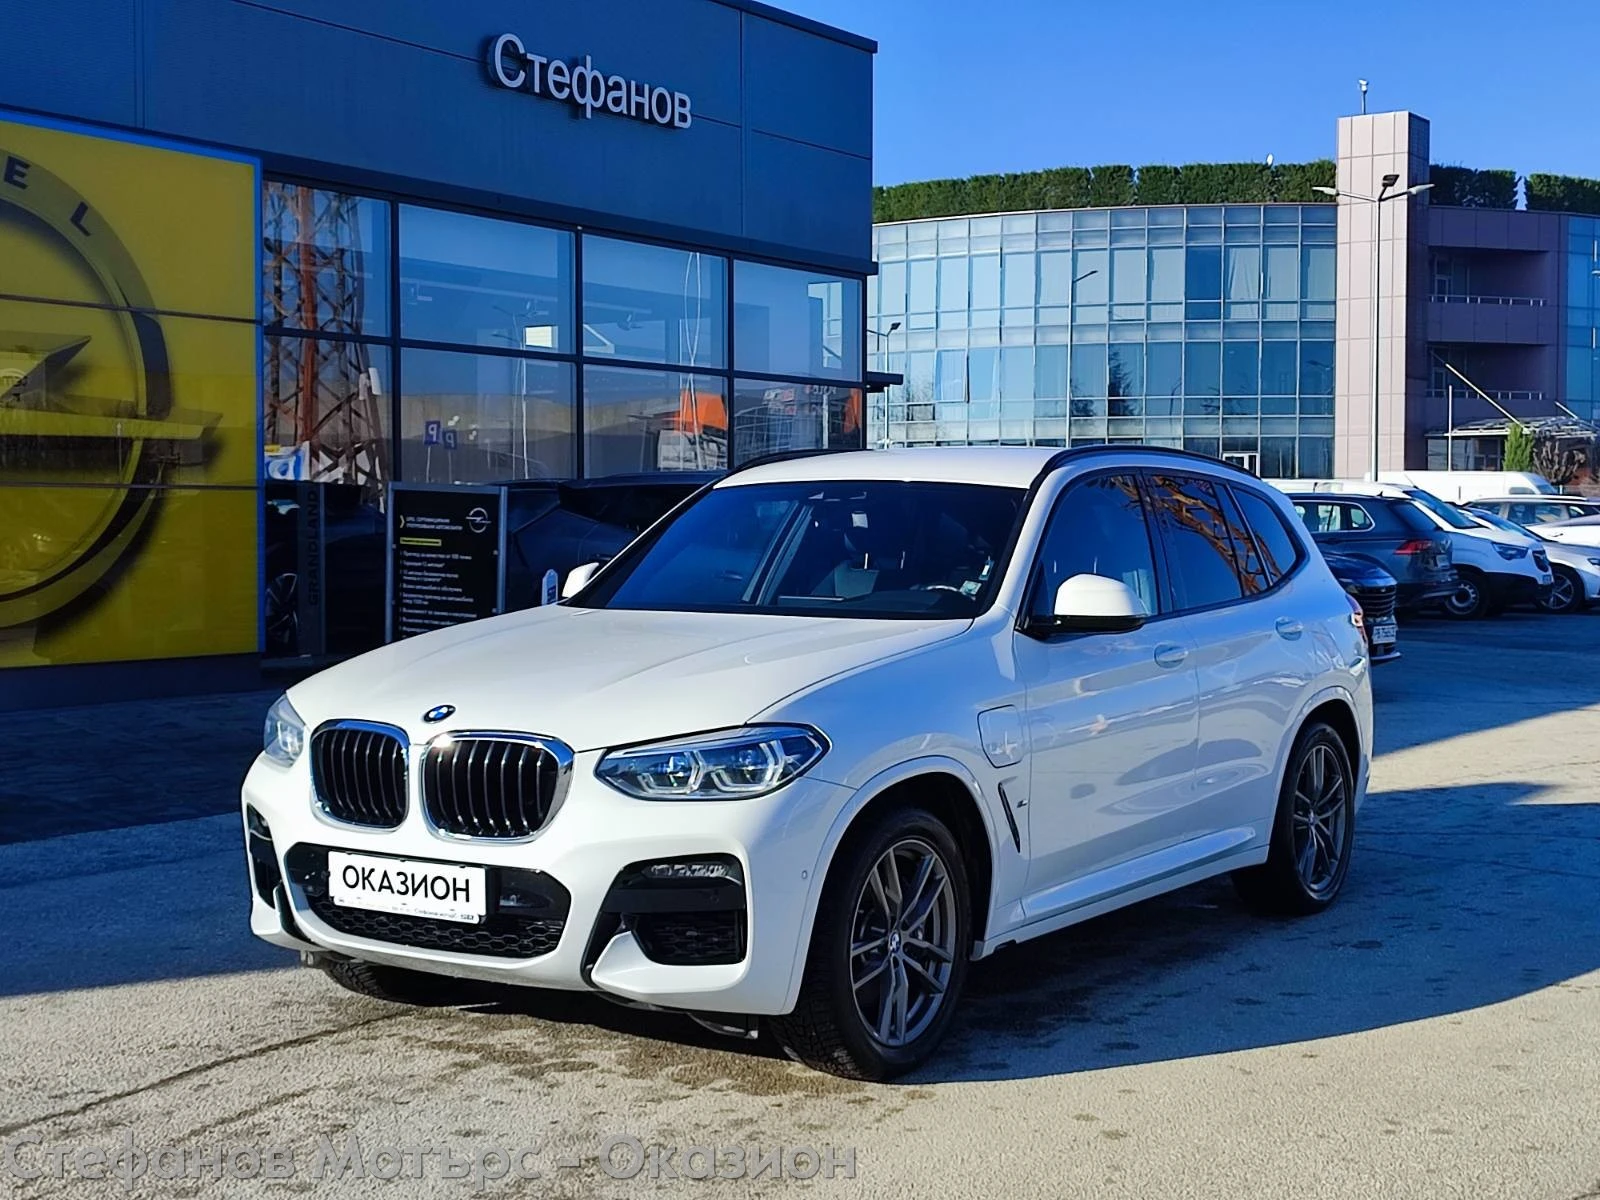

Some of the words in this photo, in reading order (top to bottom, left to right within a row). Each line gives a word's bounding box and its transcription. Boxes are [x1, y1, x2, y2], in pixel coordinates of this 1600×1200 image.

[493, 33, 692, 129] Стефанов
[307, 490, 319, 606] GRANDLAND
[342, 864, 470, 903] ОКАЗИОН
